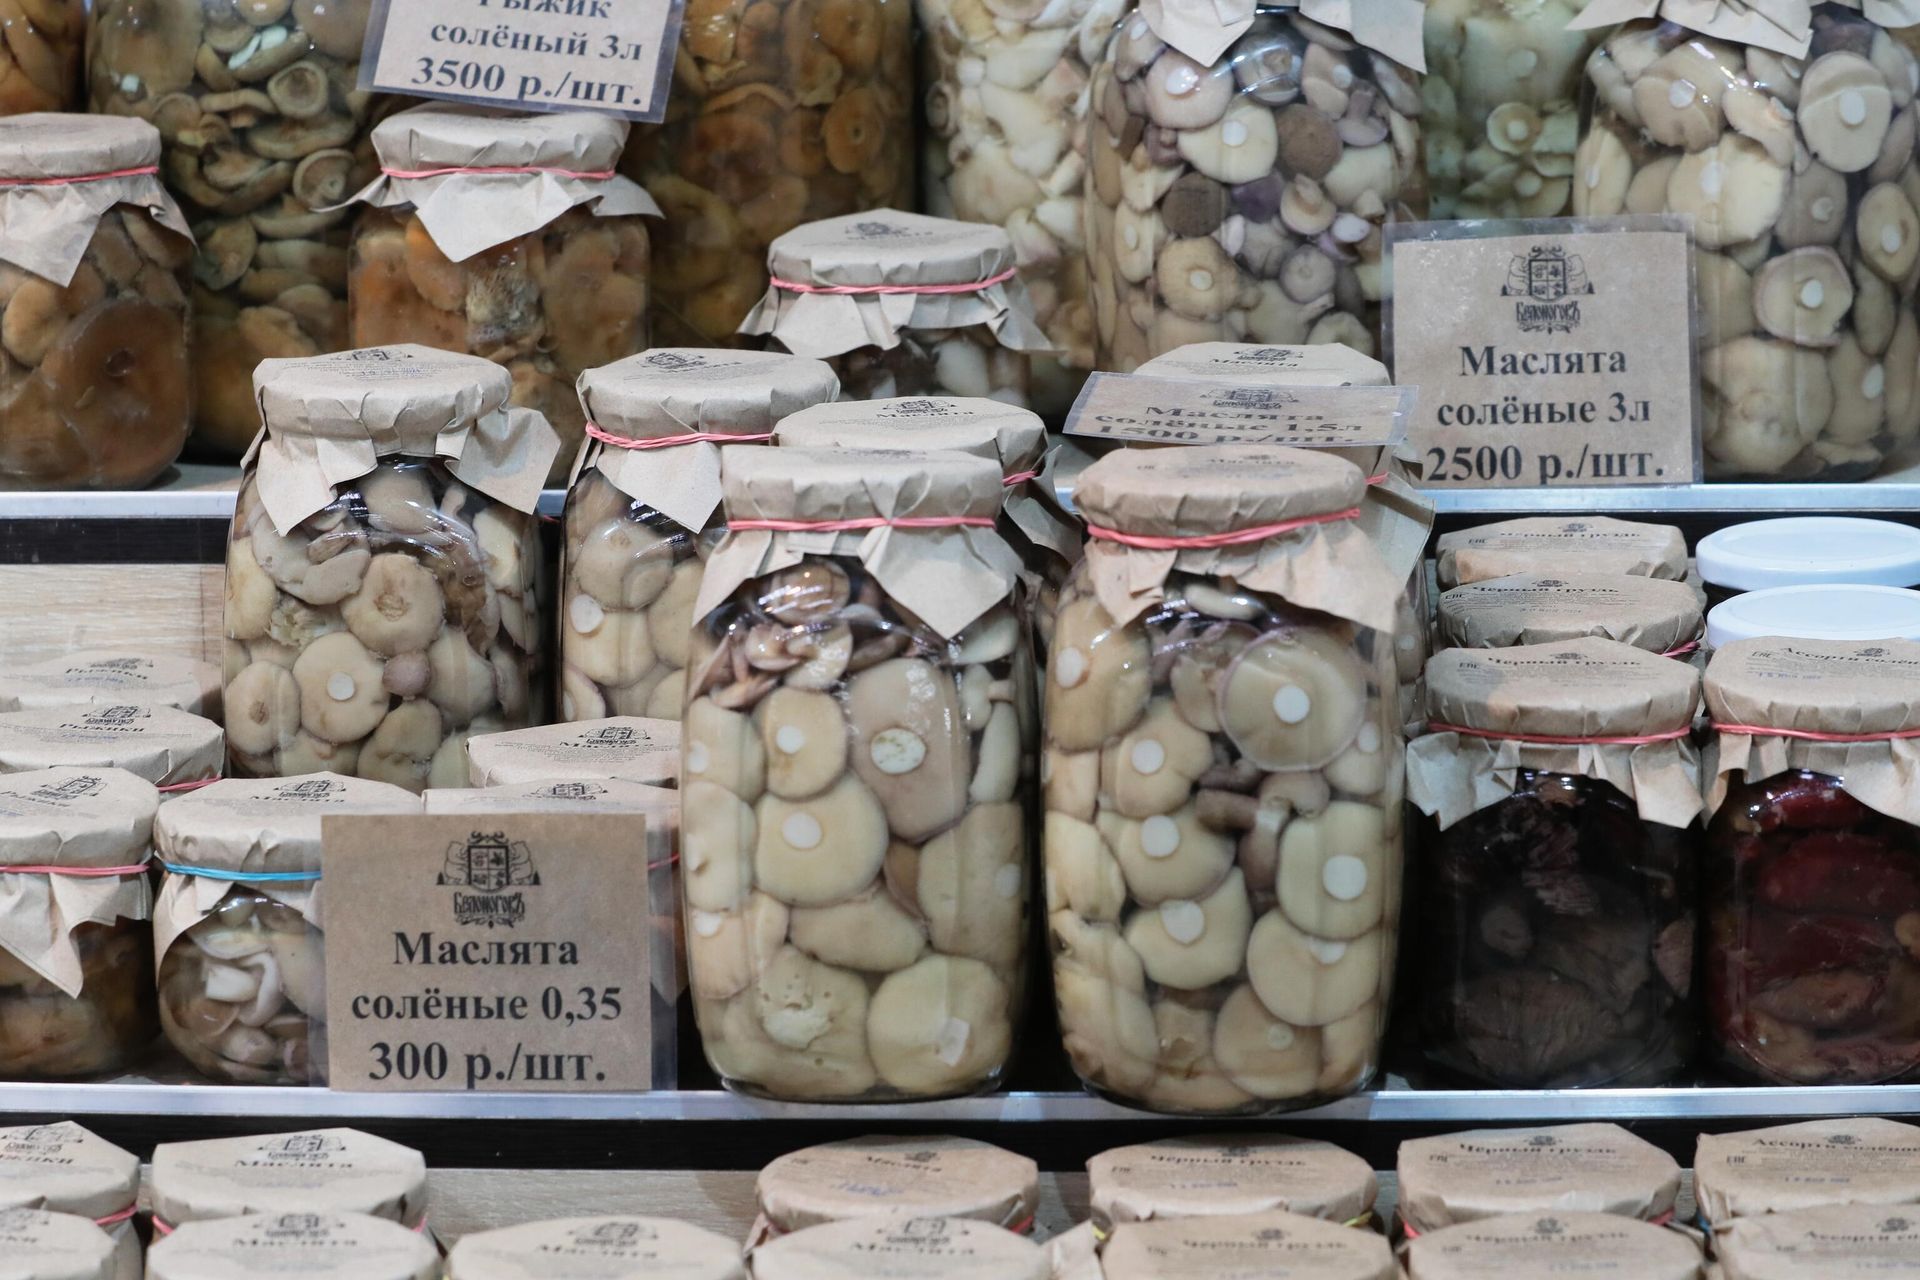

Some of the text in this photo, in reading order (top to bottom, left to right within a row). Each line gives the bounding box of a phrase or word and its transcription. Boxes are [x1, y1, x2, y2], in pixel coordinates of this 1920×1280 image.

[478, 0, 612, 18] ыжик
[430, 23, 643, 61] солёный 3л
[411, 57, 642, 105] 3500 р./шт.
[1459, 345, 1626, 376] Маслята
[1095, 413, 1269, 431] солёные
[1146, 406, 1324, 421] Маслята
[1438, 392, 1651, 426] солёные 3л
[1100, 426, 1199, 440] 1500
[1427, 443, 1664, 485] 2500 р./шт.
[393, 932, 578, 965] Маслята
[352, 986, 622, 1025] солёные 0,35
[368, 1042, 606, 1089] 300 р./шт.
